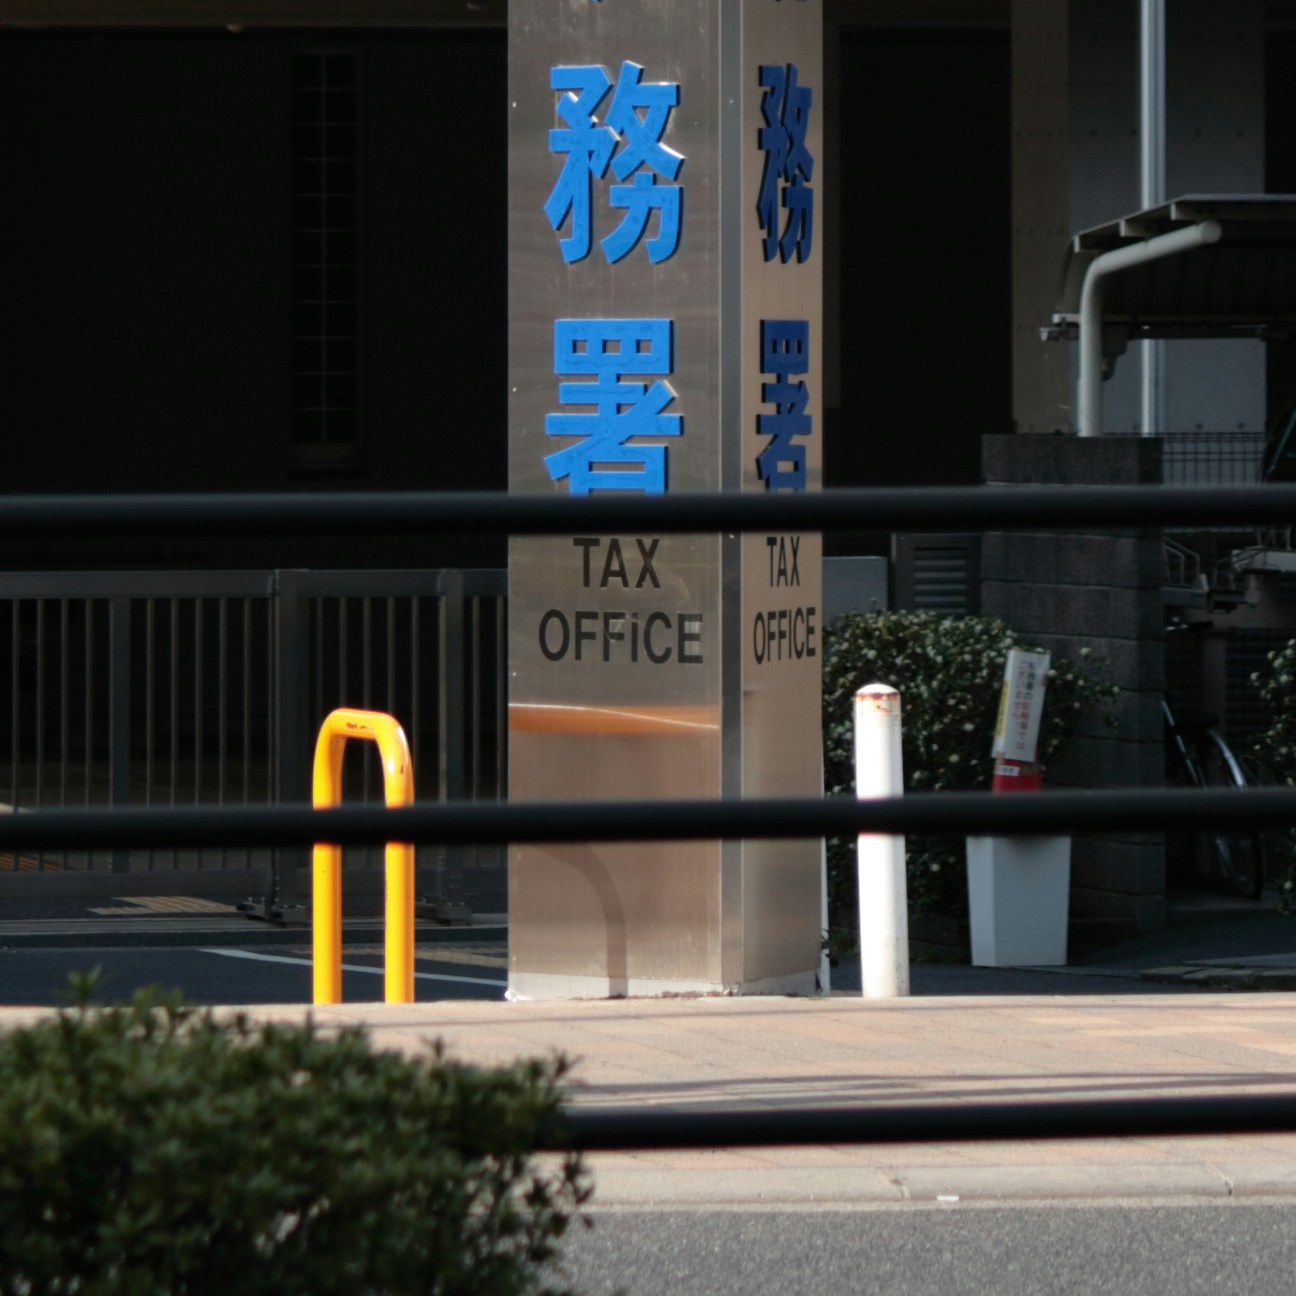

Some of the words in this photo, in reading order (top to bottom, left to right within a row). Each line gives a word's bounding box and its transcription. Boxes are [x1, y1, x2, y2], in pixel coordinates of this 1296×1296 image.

[572, 537, 662, 589] TAX
[766, 536, 801, 588] TAX
[753, 606, 816, 665] OFFICE
